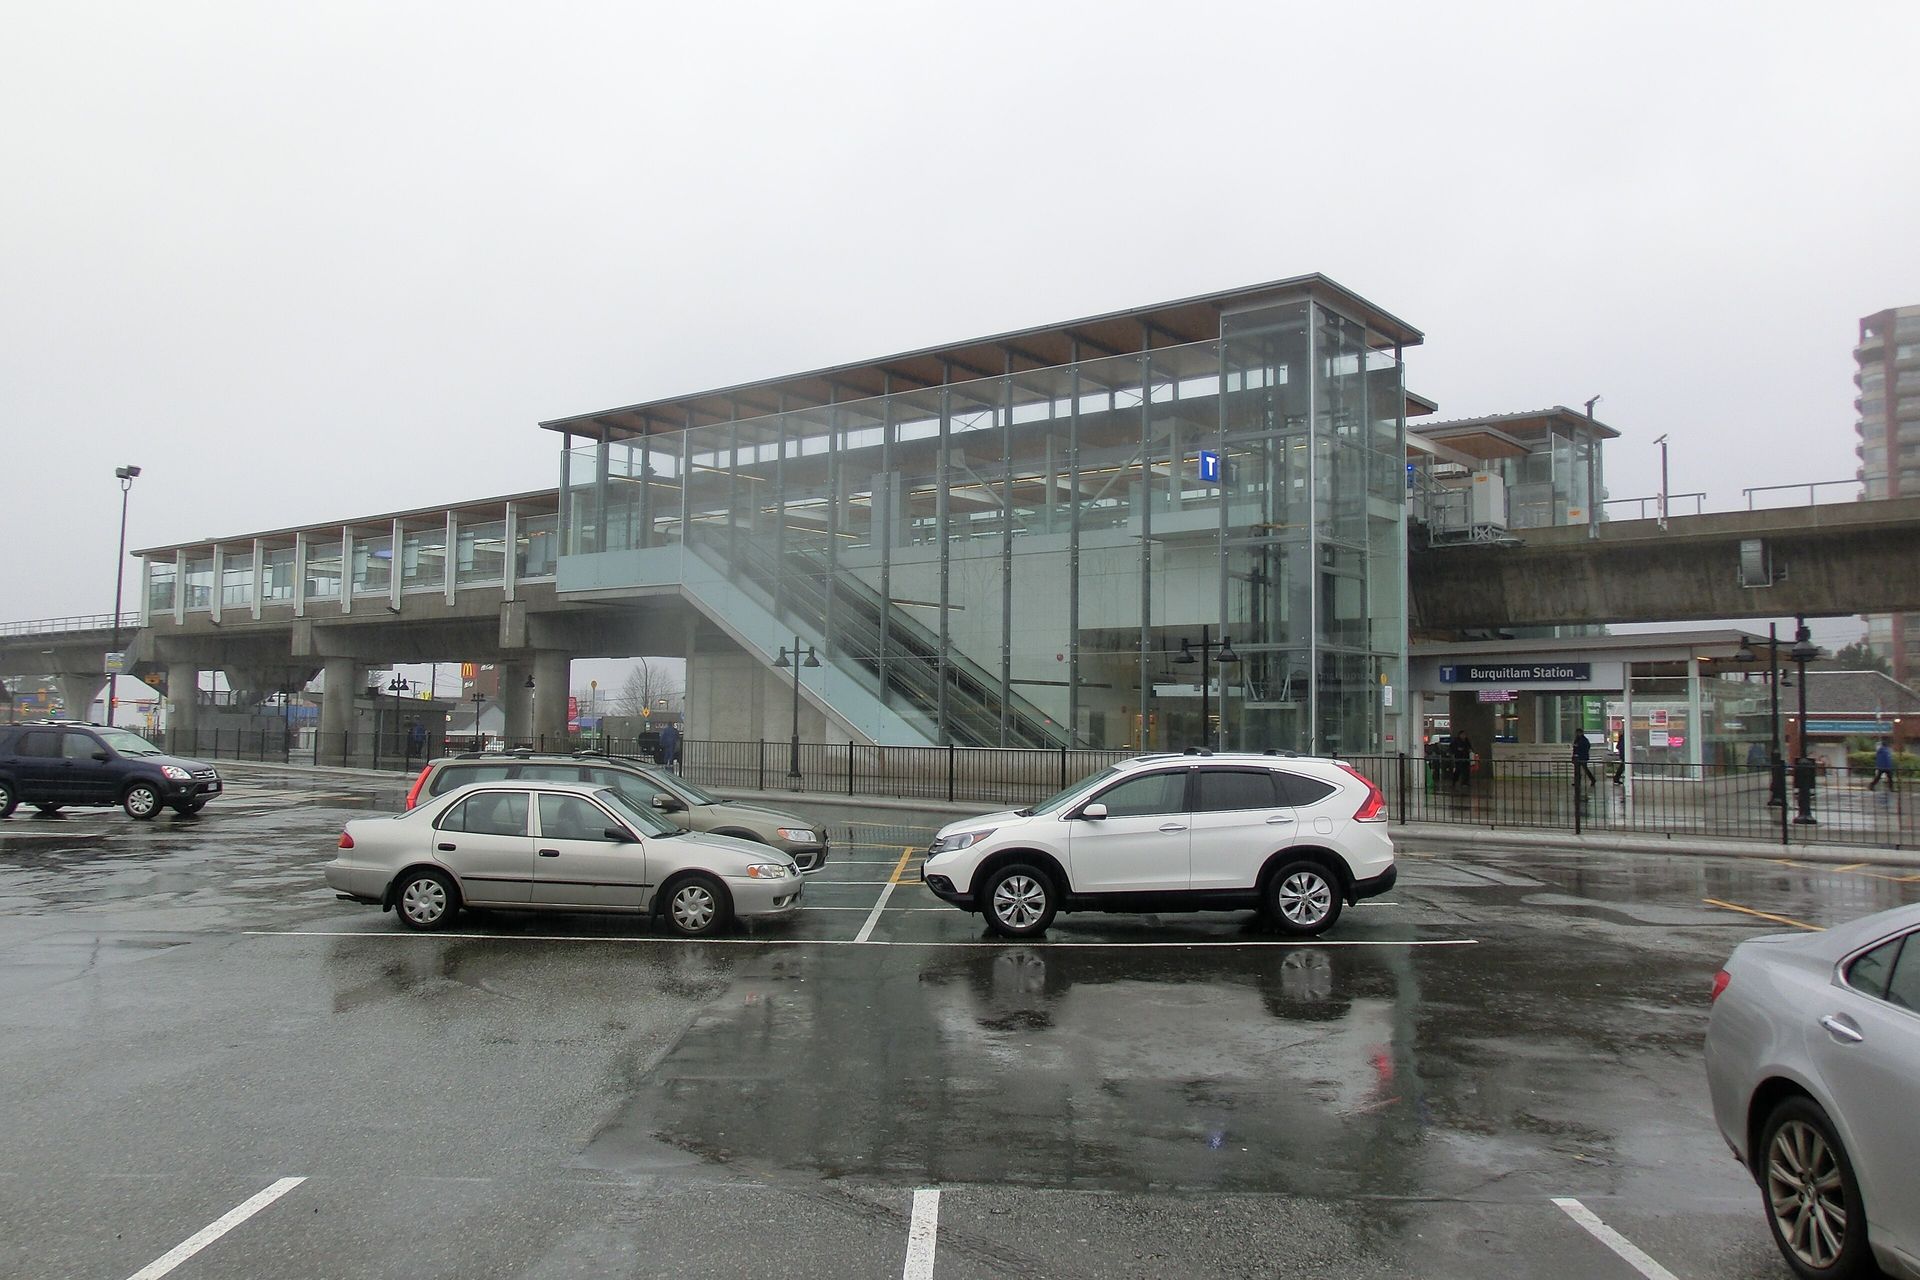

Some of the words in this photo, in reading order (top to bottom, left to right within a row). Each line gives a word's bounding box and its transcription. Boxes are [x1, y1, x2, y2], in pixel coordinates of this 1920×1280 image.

[1206, 456, 1216, 476] T
[1442, 667, 1453, 680] T
[1470, 667, 1530, 681] Burquitlam
[1533, 666, 1574, 678] Station
